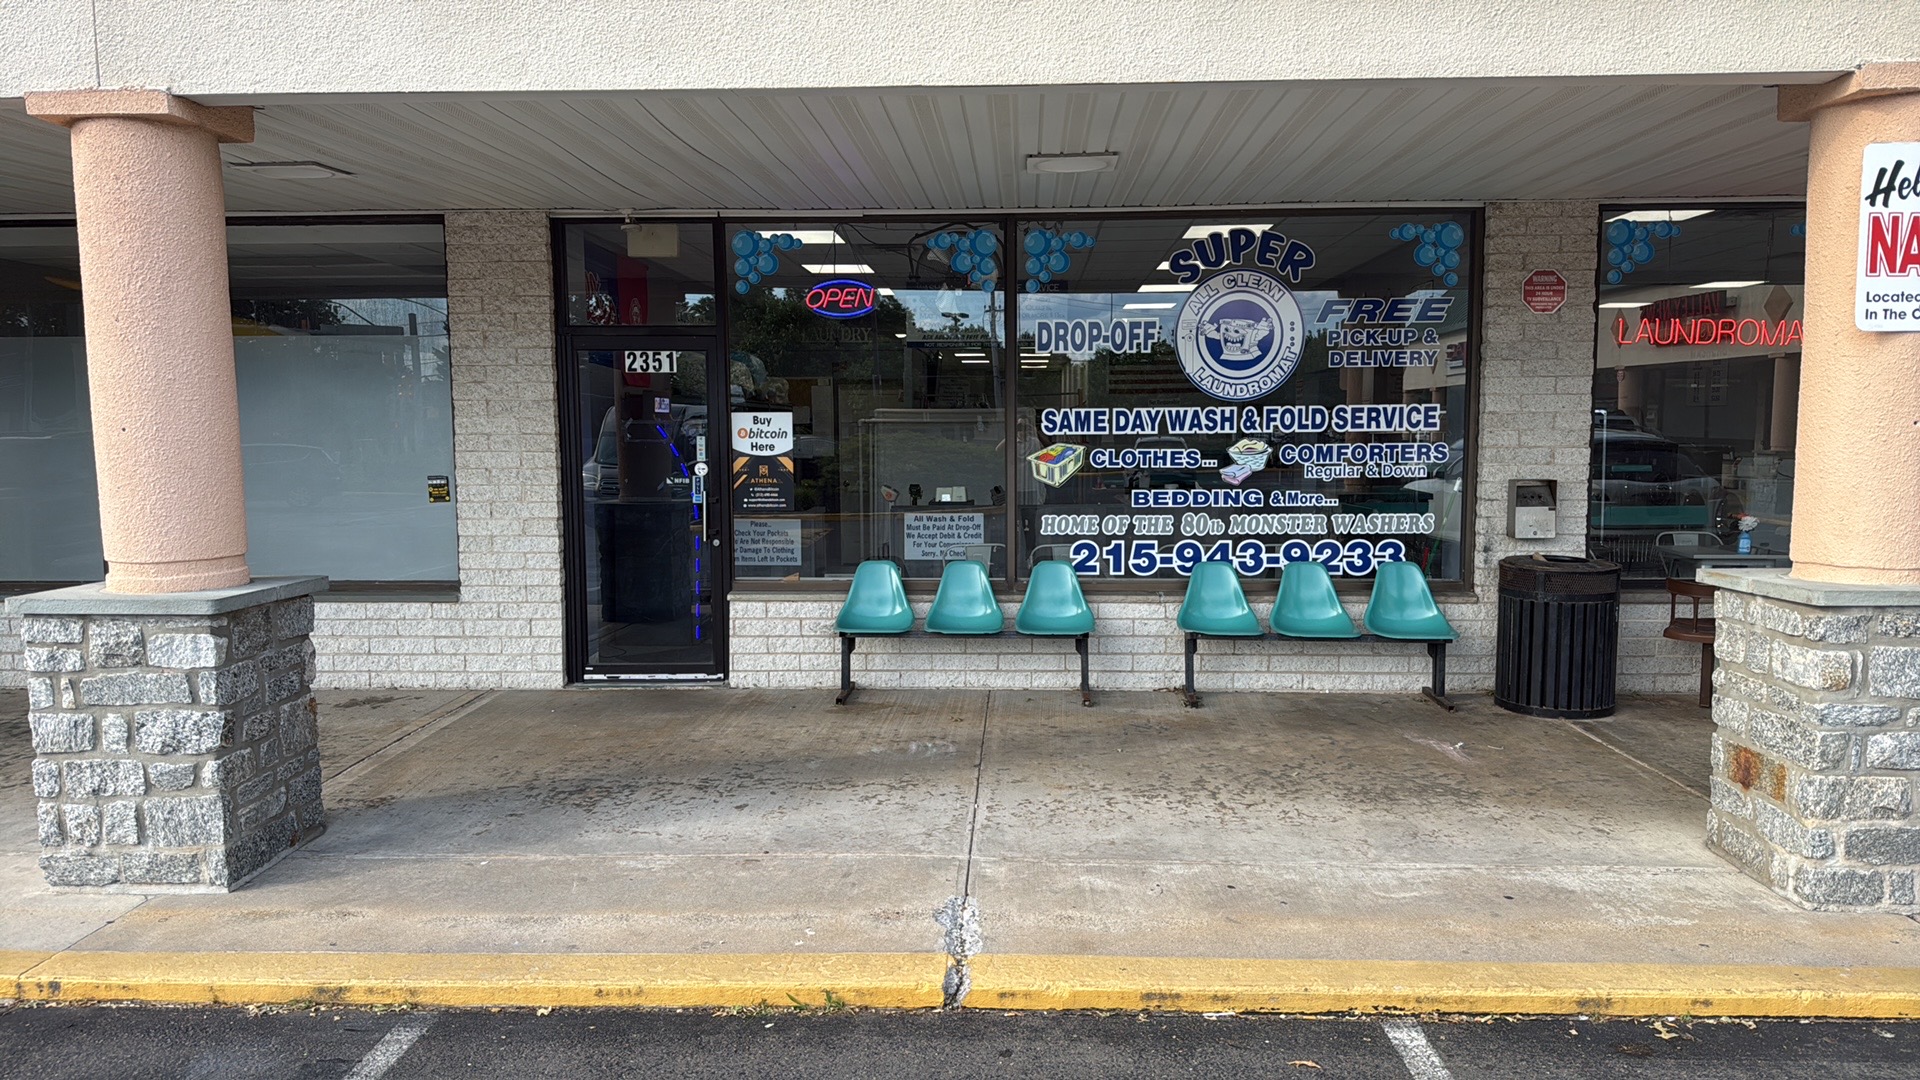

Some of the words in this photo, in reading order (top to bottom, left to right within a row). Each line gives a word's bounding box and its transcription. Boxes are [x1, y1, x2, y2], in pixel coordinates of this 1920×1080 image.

[1169, 228, 1315, 284] SUPER
[1533, 275, 1558, 283] WARNING
[806, 288, 874, 308] OPEN
[1188, 284, 1219, 315] ALL
[1223, 274, 1285, 302] CLEAN
[1314, 297, 1455, 324] FREE
[1865, 309, 1877, 320] In
[1883, 309, 1907, 320] The
[1035, 318, 1159, 354] DROP-OFF
[1326, 328, 1418, 346] PICK-UP
[1423, 328, 1440, 346] &
[627, 352, 674, 372] 2351
[1328, 349, 1440, 368] DELIVERY
[1193, 348, 1297, 397] LAUNDROMAT
[752, 416, 772, 427] Buy
[1041, 407, 1110, 435] SAME
[1112, 407, 1164, 434] DAY
[1163, 406, 1237, 434] WASH
[1240, 405, 1263, 433] &
[1263, 405, 1329, 433] FOLD
[1332, 403, 1440, 432] SERVICE
[748, 428, 788, 439] bitcoin
[751, 442, 775, 452] Here
[1279, 442, 1449, 464] COMFORTERS
[1090, 448, 1218, 468] CLOTHES...
[1304, 464, 1363, 481] Regular
[1365, 464, 1379, 478] &
[1382, 463, 1427, 478] Down
[1131, 489, 1264, 507] BEDDING
[1269, 491, 1285, 506] &
[1286, 490, 1339, 506] More...
[956, 524, 981, 532] Drop-Off
[1040, 514, 1100, 535] HOME
[1102, 514, 1130, 535] OF
[1133, 514, 1174, 535] THE
[1228, 513, 1328, 535] MONSTER
[1331, 513, 1435, 534] WASHERS
[762, 538, 794, 546] Responsible
[772, 547, 795, 555] Clothing
[1069, 539, 1405, 576] 215-943-9233
